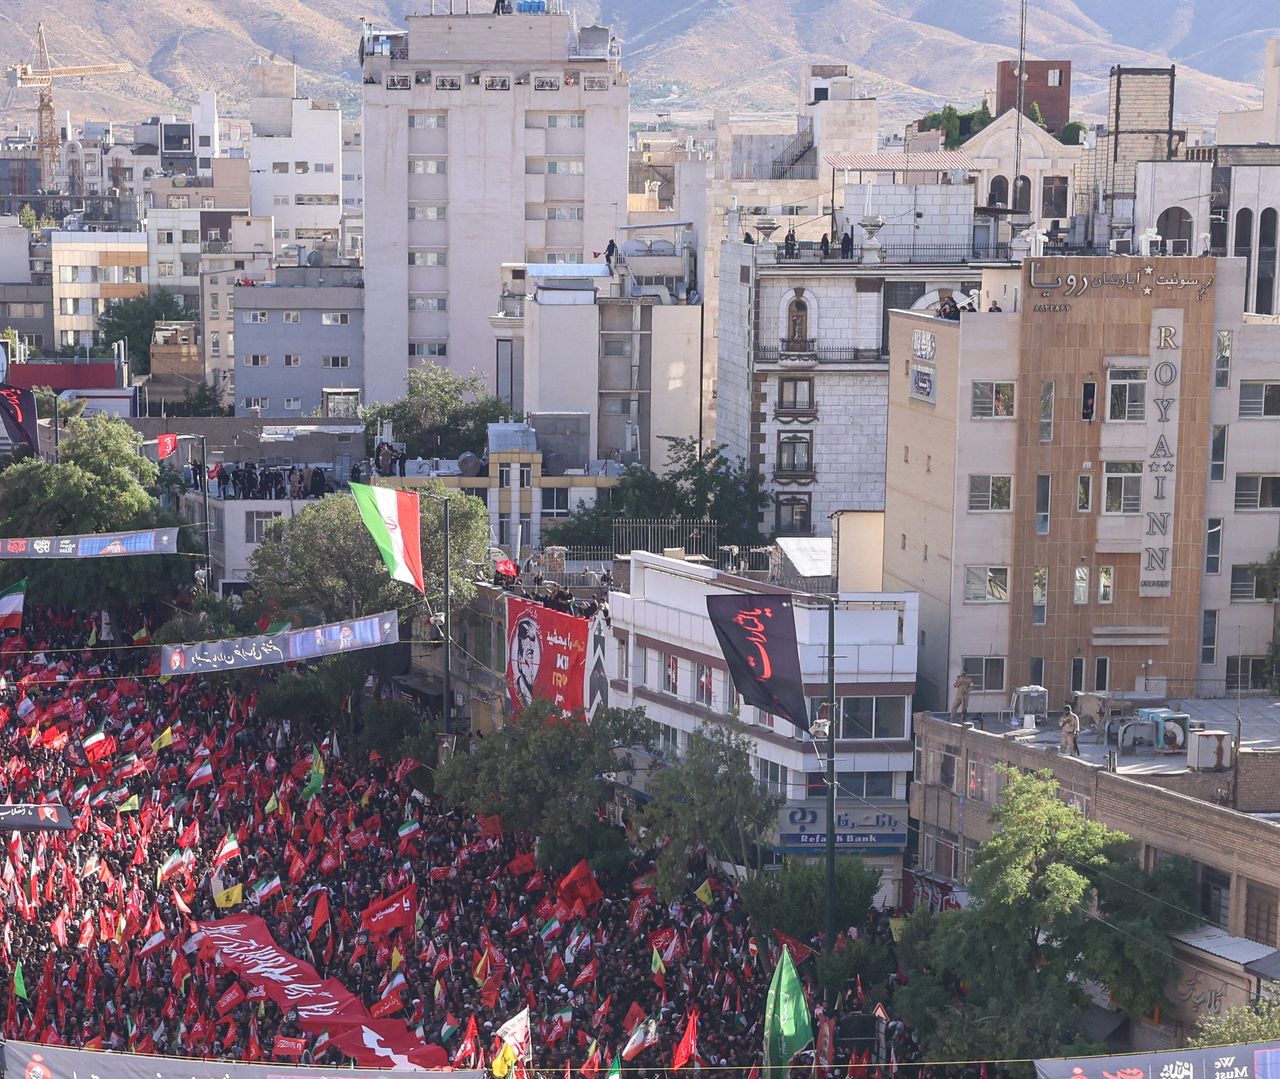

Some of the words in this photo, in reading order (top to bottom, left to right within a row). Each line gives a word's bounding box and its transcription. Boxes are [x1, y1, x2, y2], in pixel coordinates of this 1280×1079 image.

[1029, 261, 1089, 298] رویا
[1092, 268, 1141, 293] آپارتمان
[1150, 323, 1179, 460] ROYA
[1145, 473, 1171, 572] INN
[858, 814, 898, 832] بانک
[801, 834, 827, 843] Refa
[846, 834, 877, 843] Bank
[371, 902, 401, 922] حسین
[402, 895, 410, 911] یا
